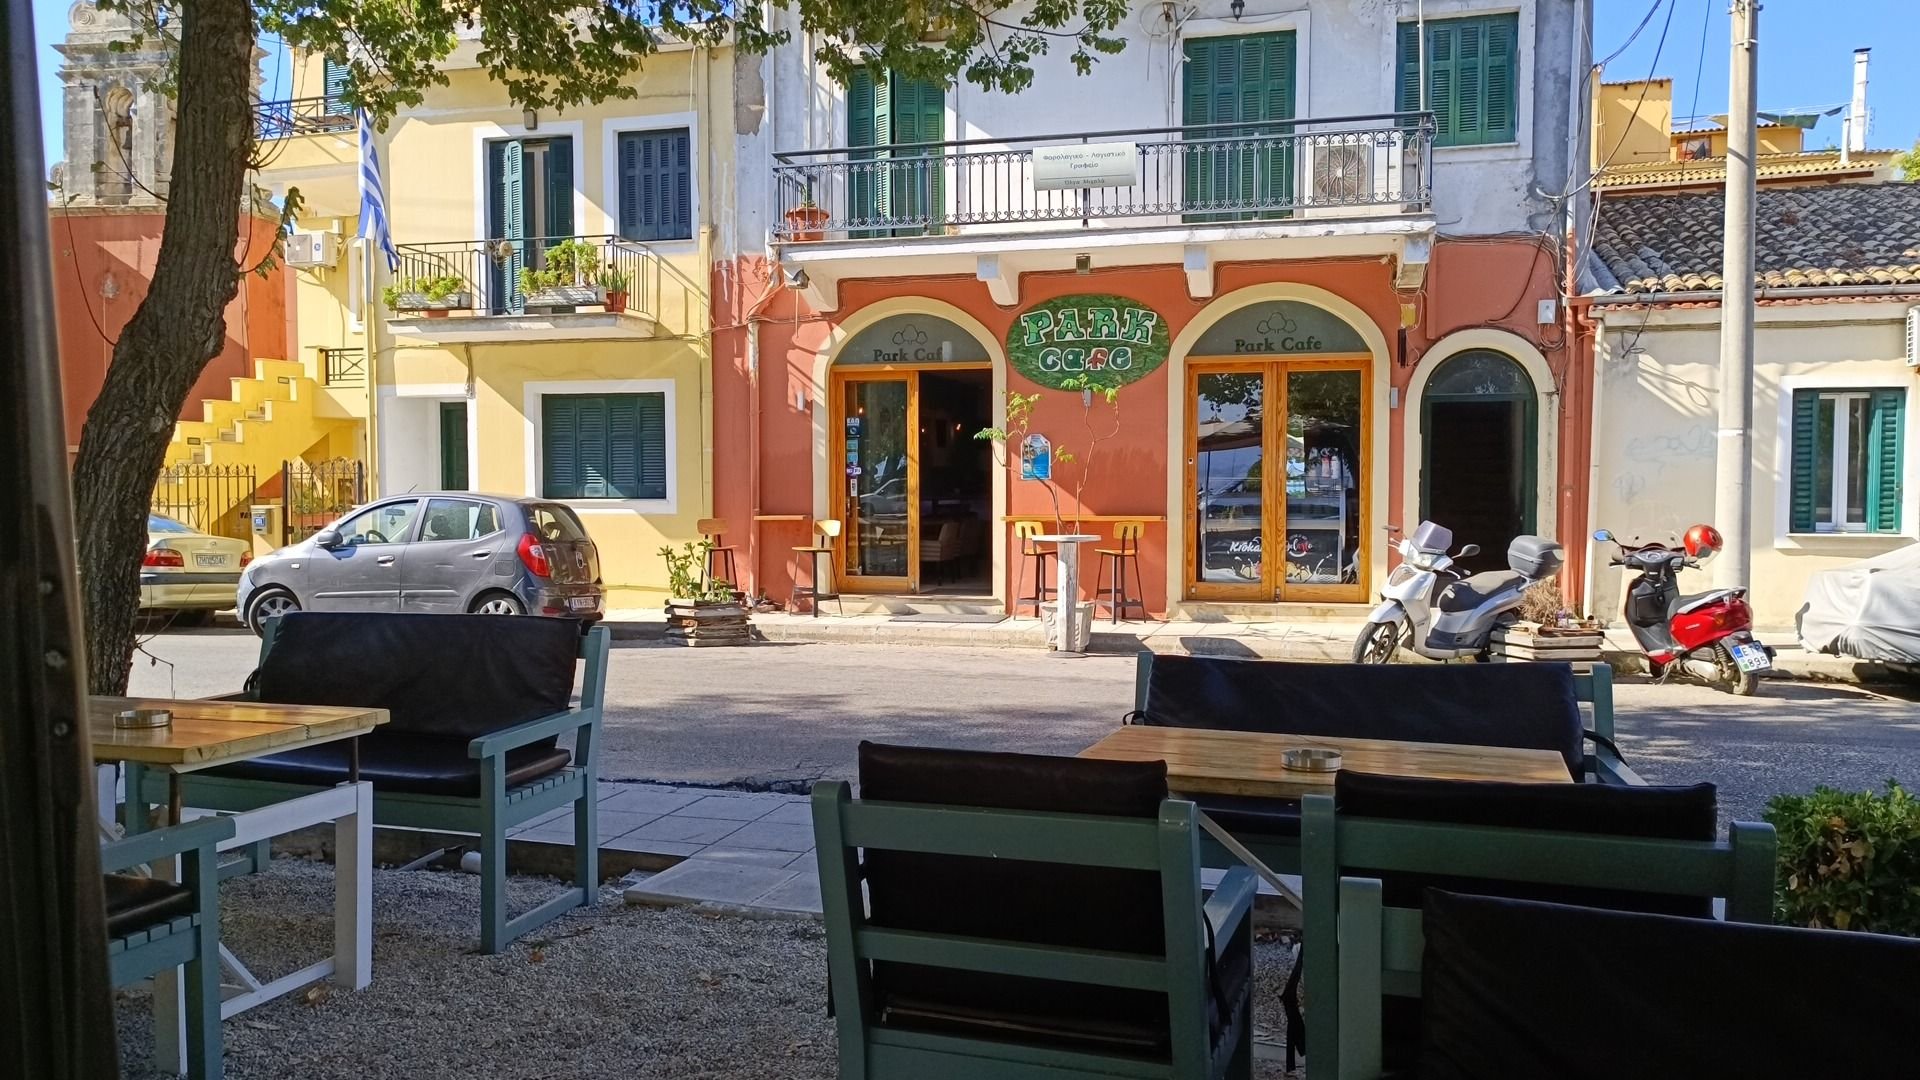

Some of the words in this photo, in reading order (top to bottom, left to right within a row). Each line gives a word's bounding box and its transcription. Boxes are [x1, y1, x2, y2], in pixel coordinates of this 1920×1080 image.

[1070, 162, 1098, 170] Γραφείο
[1020, 307, 1158, 346] PARK
[1234, 337, 1276, 353] Park
[1280, 335, 1323, 351] Cafe
[873, 348, 908, 362] Park
[913, 347, 944, 361] Caf
[1748, 656, 1767, 667] 895
